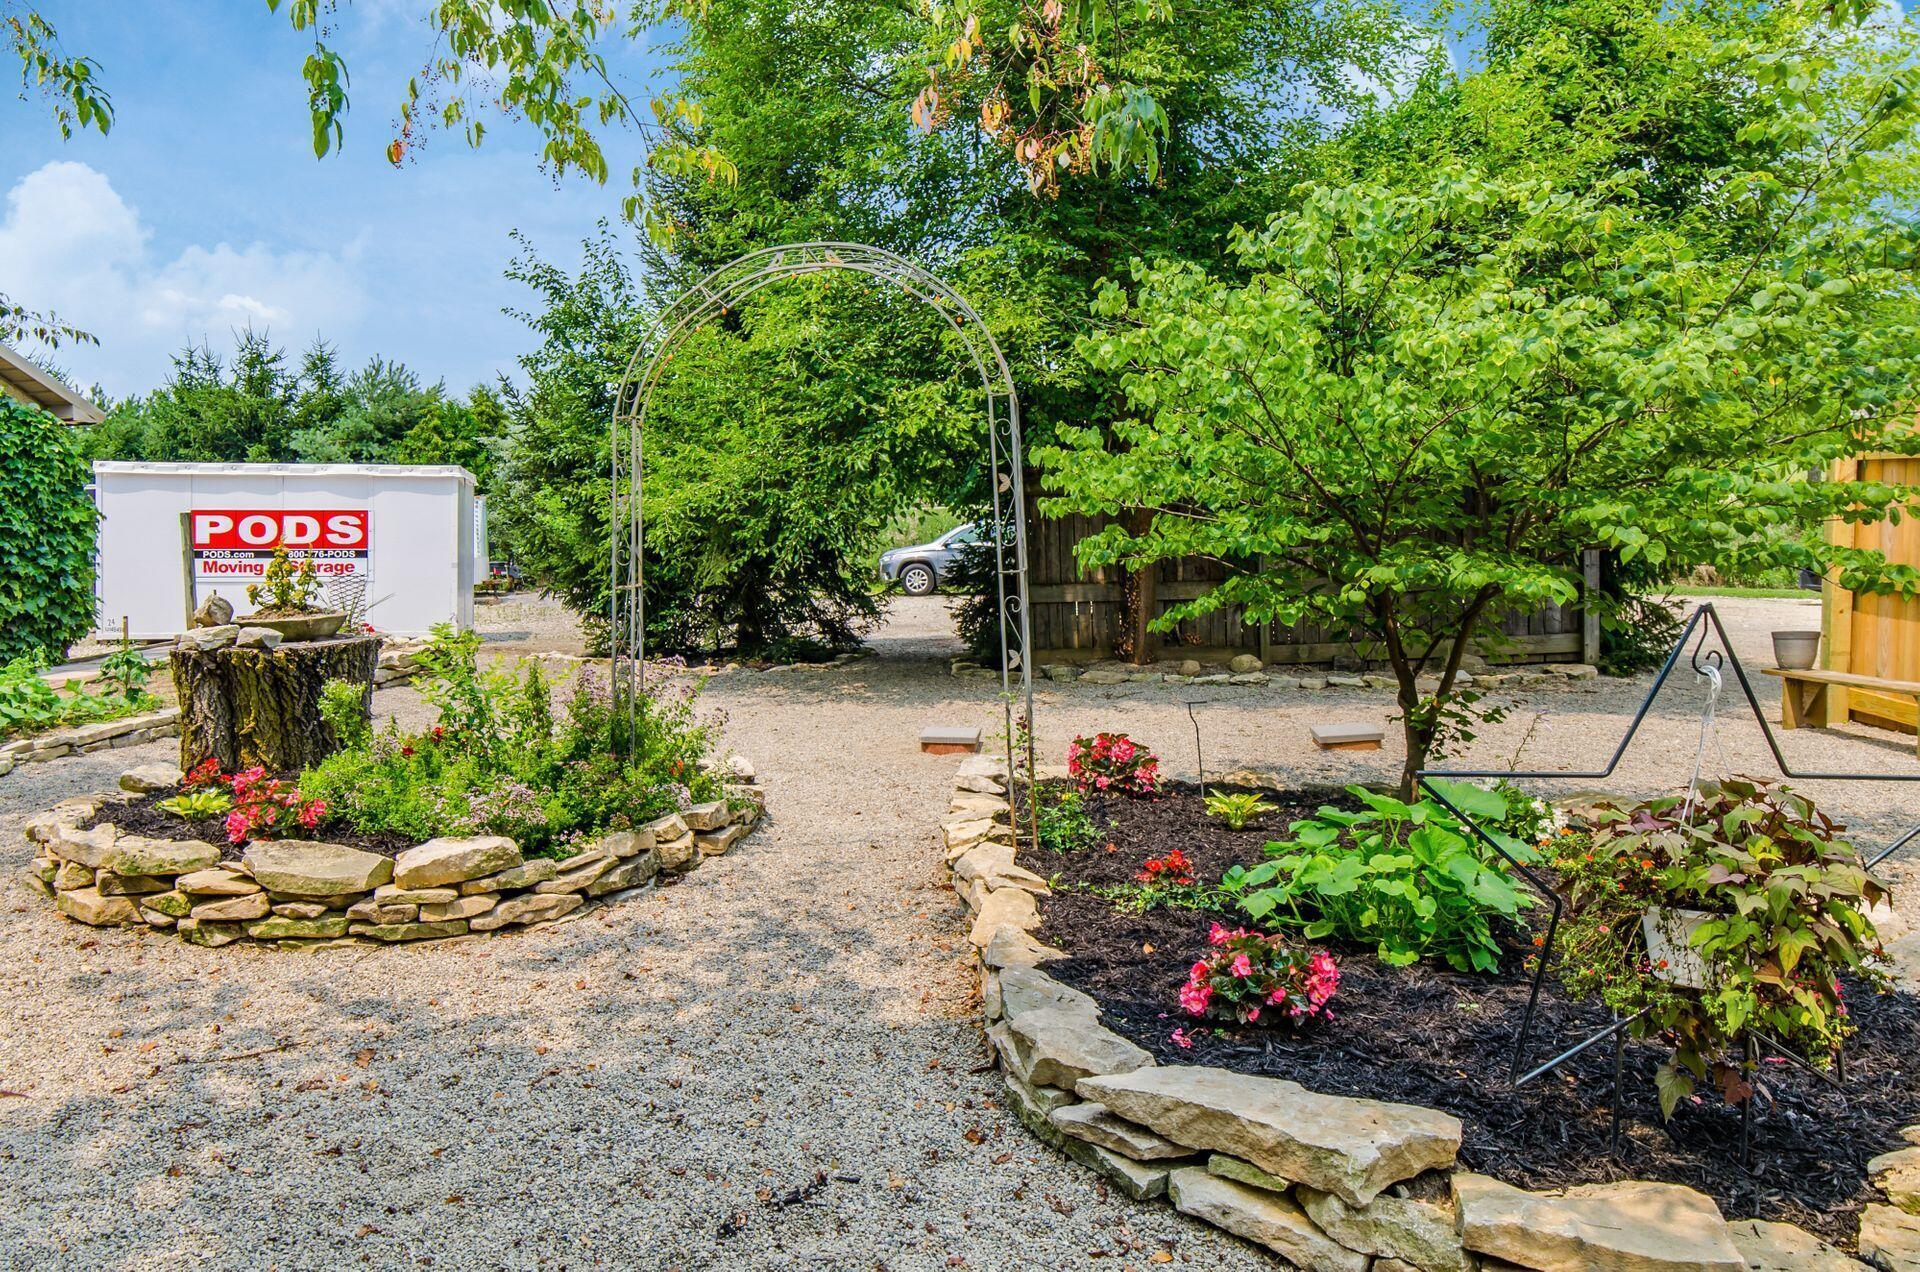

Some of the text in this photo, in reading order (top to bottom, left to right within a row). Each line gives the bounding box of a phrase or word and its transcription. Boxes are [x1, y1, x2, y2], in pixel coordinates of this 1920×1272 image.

[195, 514, 363, 545] PODS
[202, 550, 255, 559] PODS.com
[287, 550, 356, 559] 800-76-PODS
[203, 560, 356, 576] Moving Srage
